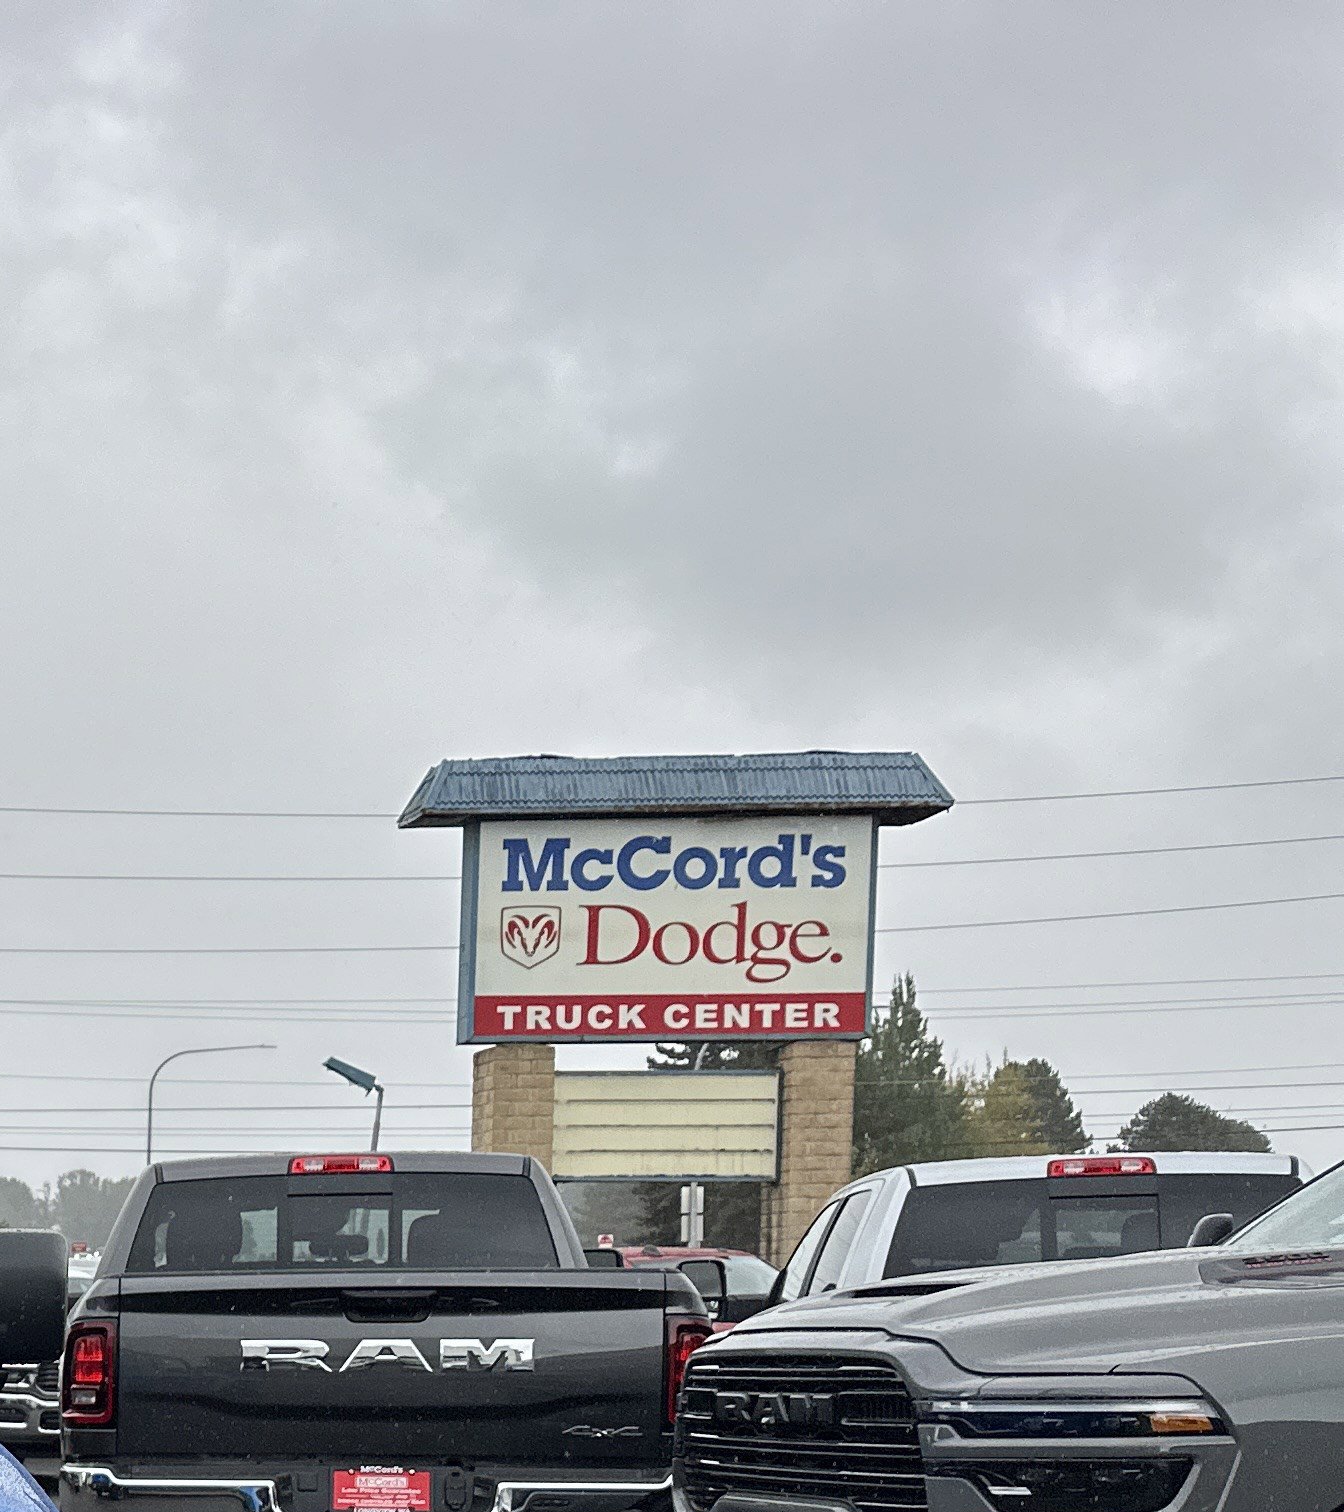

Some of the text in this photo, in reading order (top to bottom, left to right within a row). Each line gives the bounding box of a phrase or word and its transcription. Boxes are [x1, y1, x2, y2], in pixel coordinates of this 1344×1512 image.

[501, 834, 847, 892] McCord's
[576, 901, 843, 983] Dodge.
[497, 1002, 840, 1030] TRUCK CENTER
[239, 1338, 535, 1372] RAM
